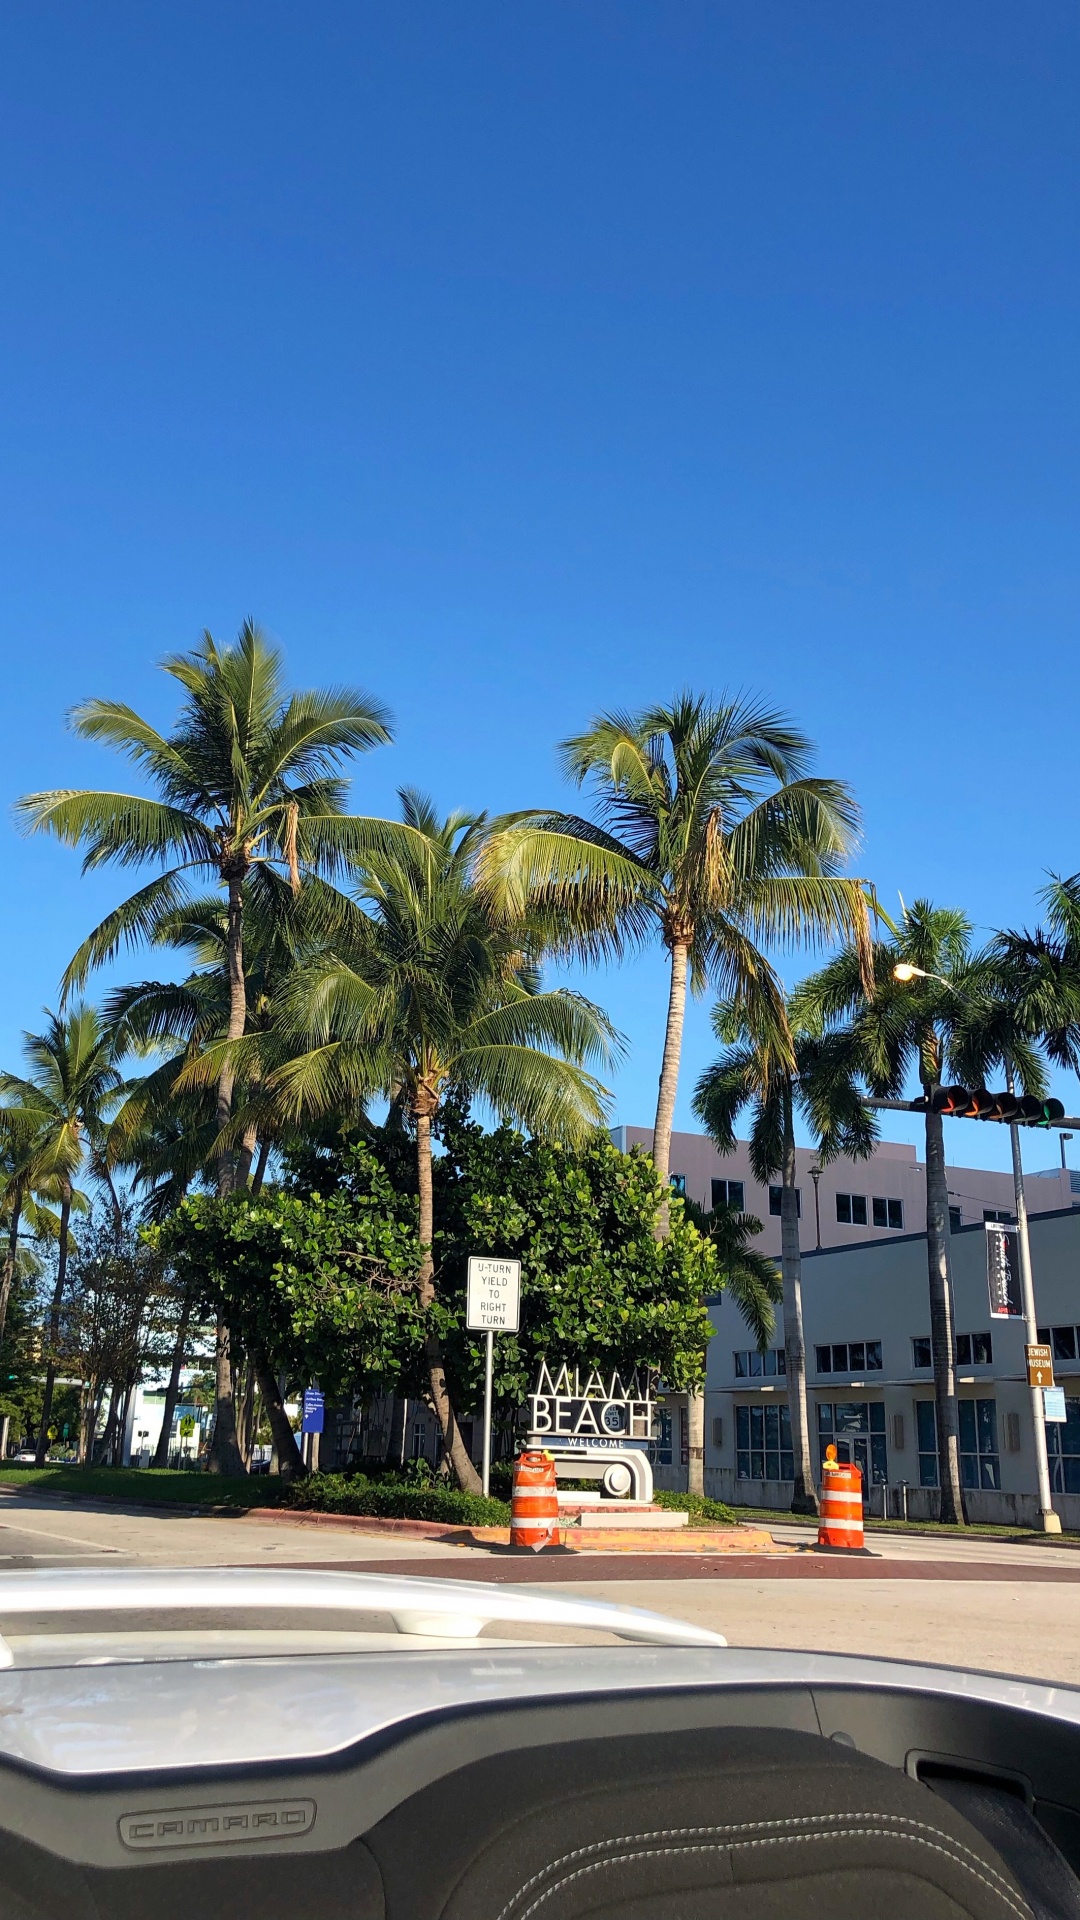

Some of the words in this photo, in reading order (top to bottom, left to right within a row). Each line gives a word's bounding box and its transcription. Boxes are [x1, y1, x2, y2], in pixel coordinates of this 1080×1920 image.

[478, 1263, 512, 1275] U-TURN
[481, 1276, 508, 1287] YIELD
[1001, 1269, 1013, 1306] Beach
[488, 1288, 500, 1299] TO
[480, 1301, 507, 1313] RIGHT
[481, 1314, 506, 1325] TURN
[1028, 1347, 1048, 1357] JEWISH
[1027, 1359, 1051, 1368] MUSEUM
[536, 1360, 650, 1402] MIAMI
[533, 1396, 652, 1437] BEACH
[605, 1416, 619, 1426] 35
[567, 1437, 624, 1449] WELCOME
[128, 1809, 306, 1839] CAMARO
